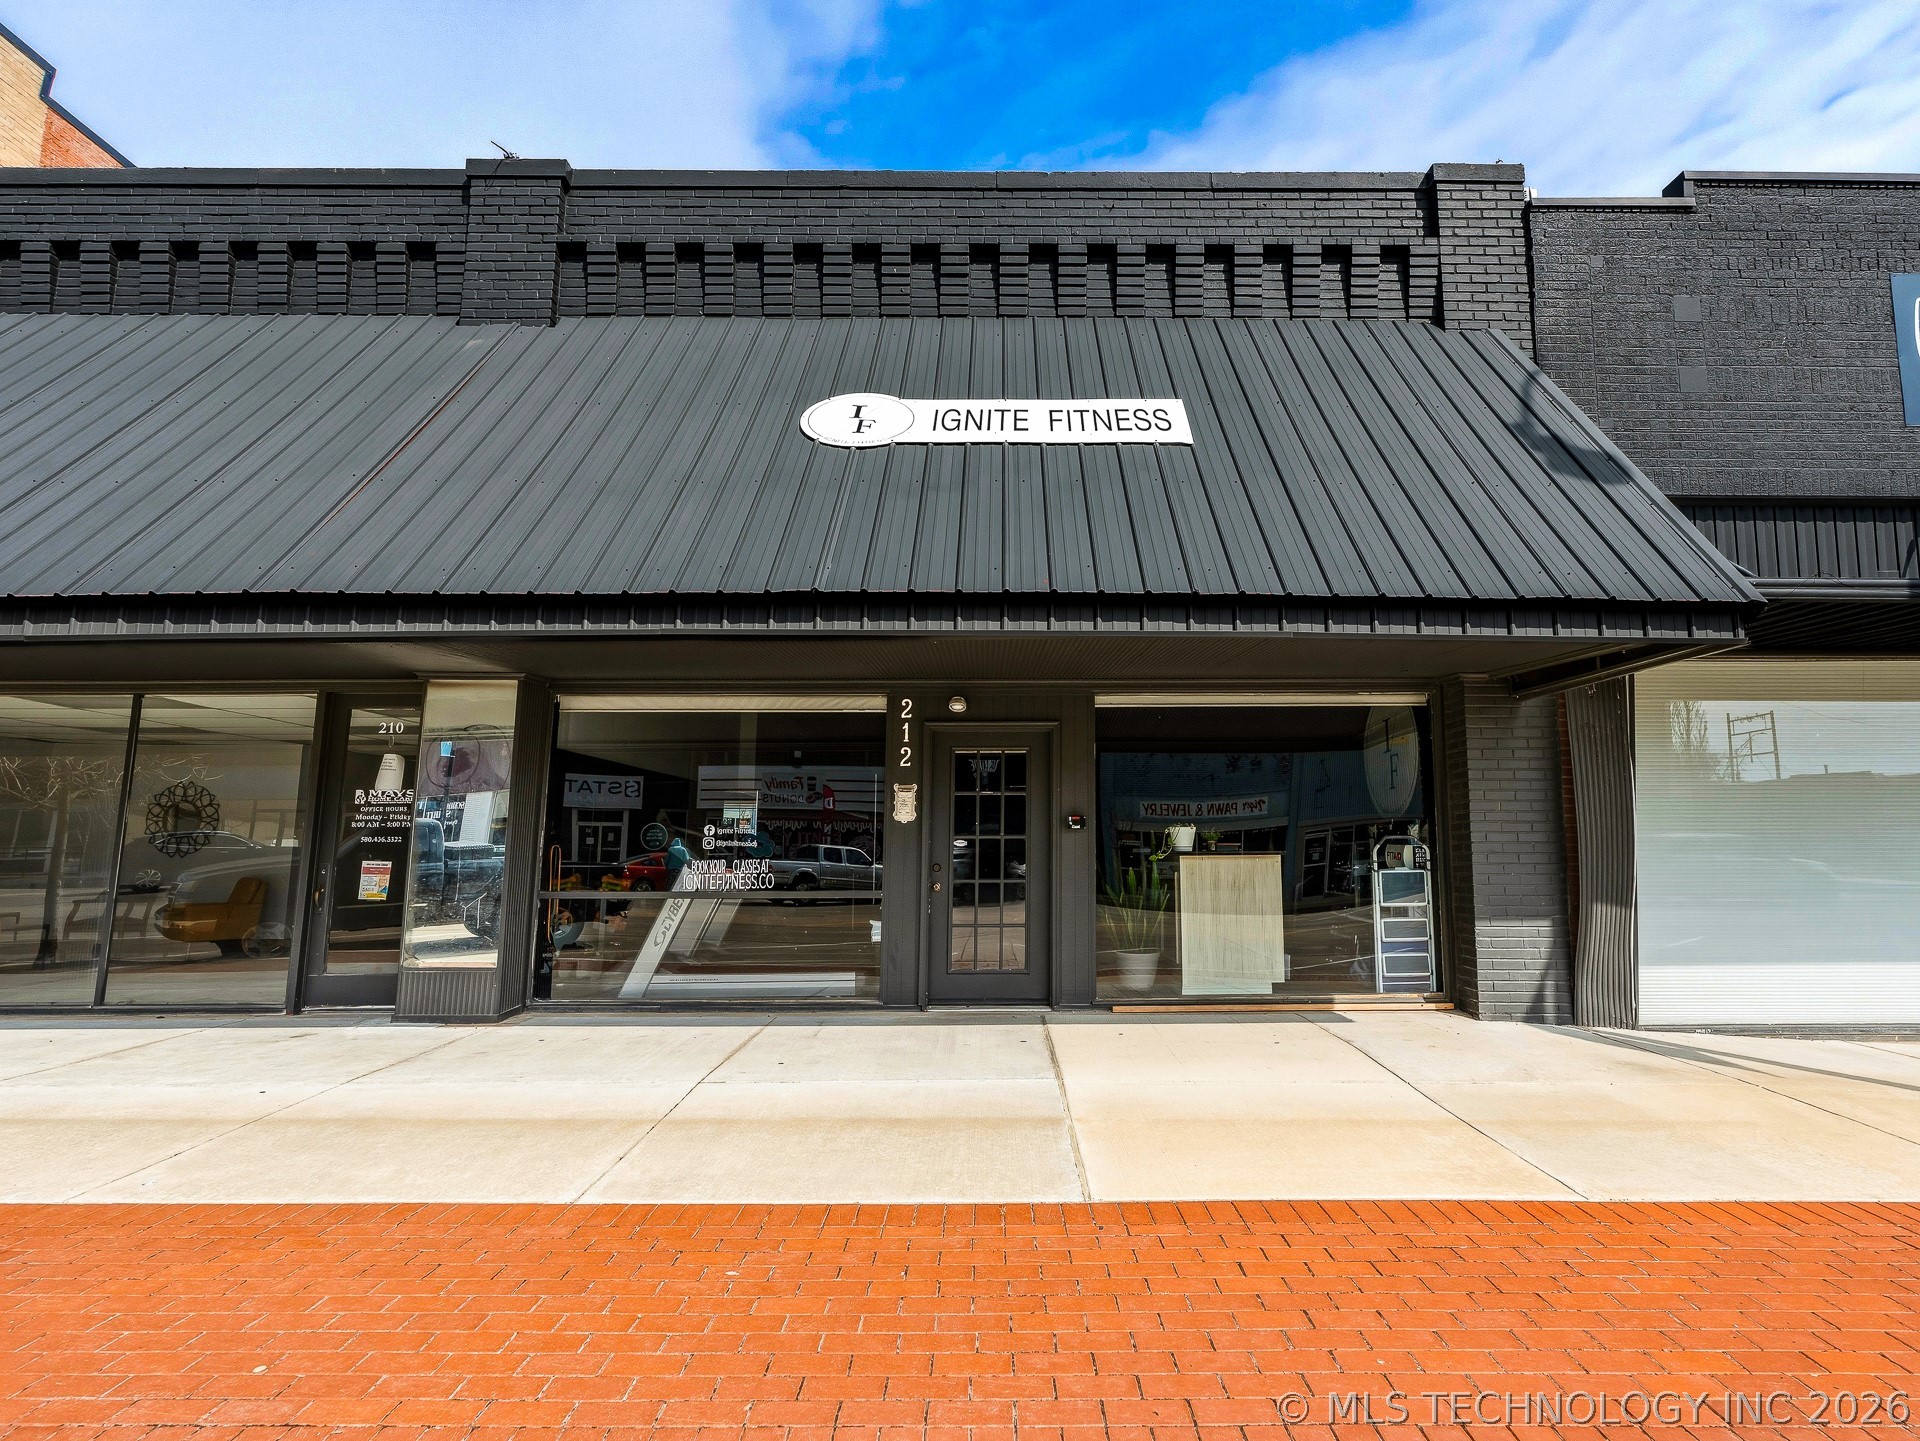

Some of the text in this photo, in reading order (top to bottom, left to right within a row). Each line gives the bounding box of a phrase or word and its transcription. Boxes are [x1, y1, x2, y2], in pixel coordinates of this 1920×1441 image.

[932, 409, 1173, 432] IGNITE FITNESS
[378, 721, 404, 734] 210
[900, 698, 913, 767] 212
[368, 789, 415, 798] MAYS
[691, 860, 769, 874] BOOK YOUR CLASSES AT
[682, 873, 775, 891] IGNITEFITNESS.CO
